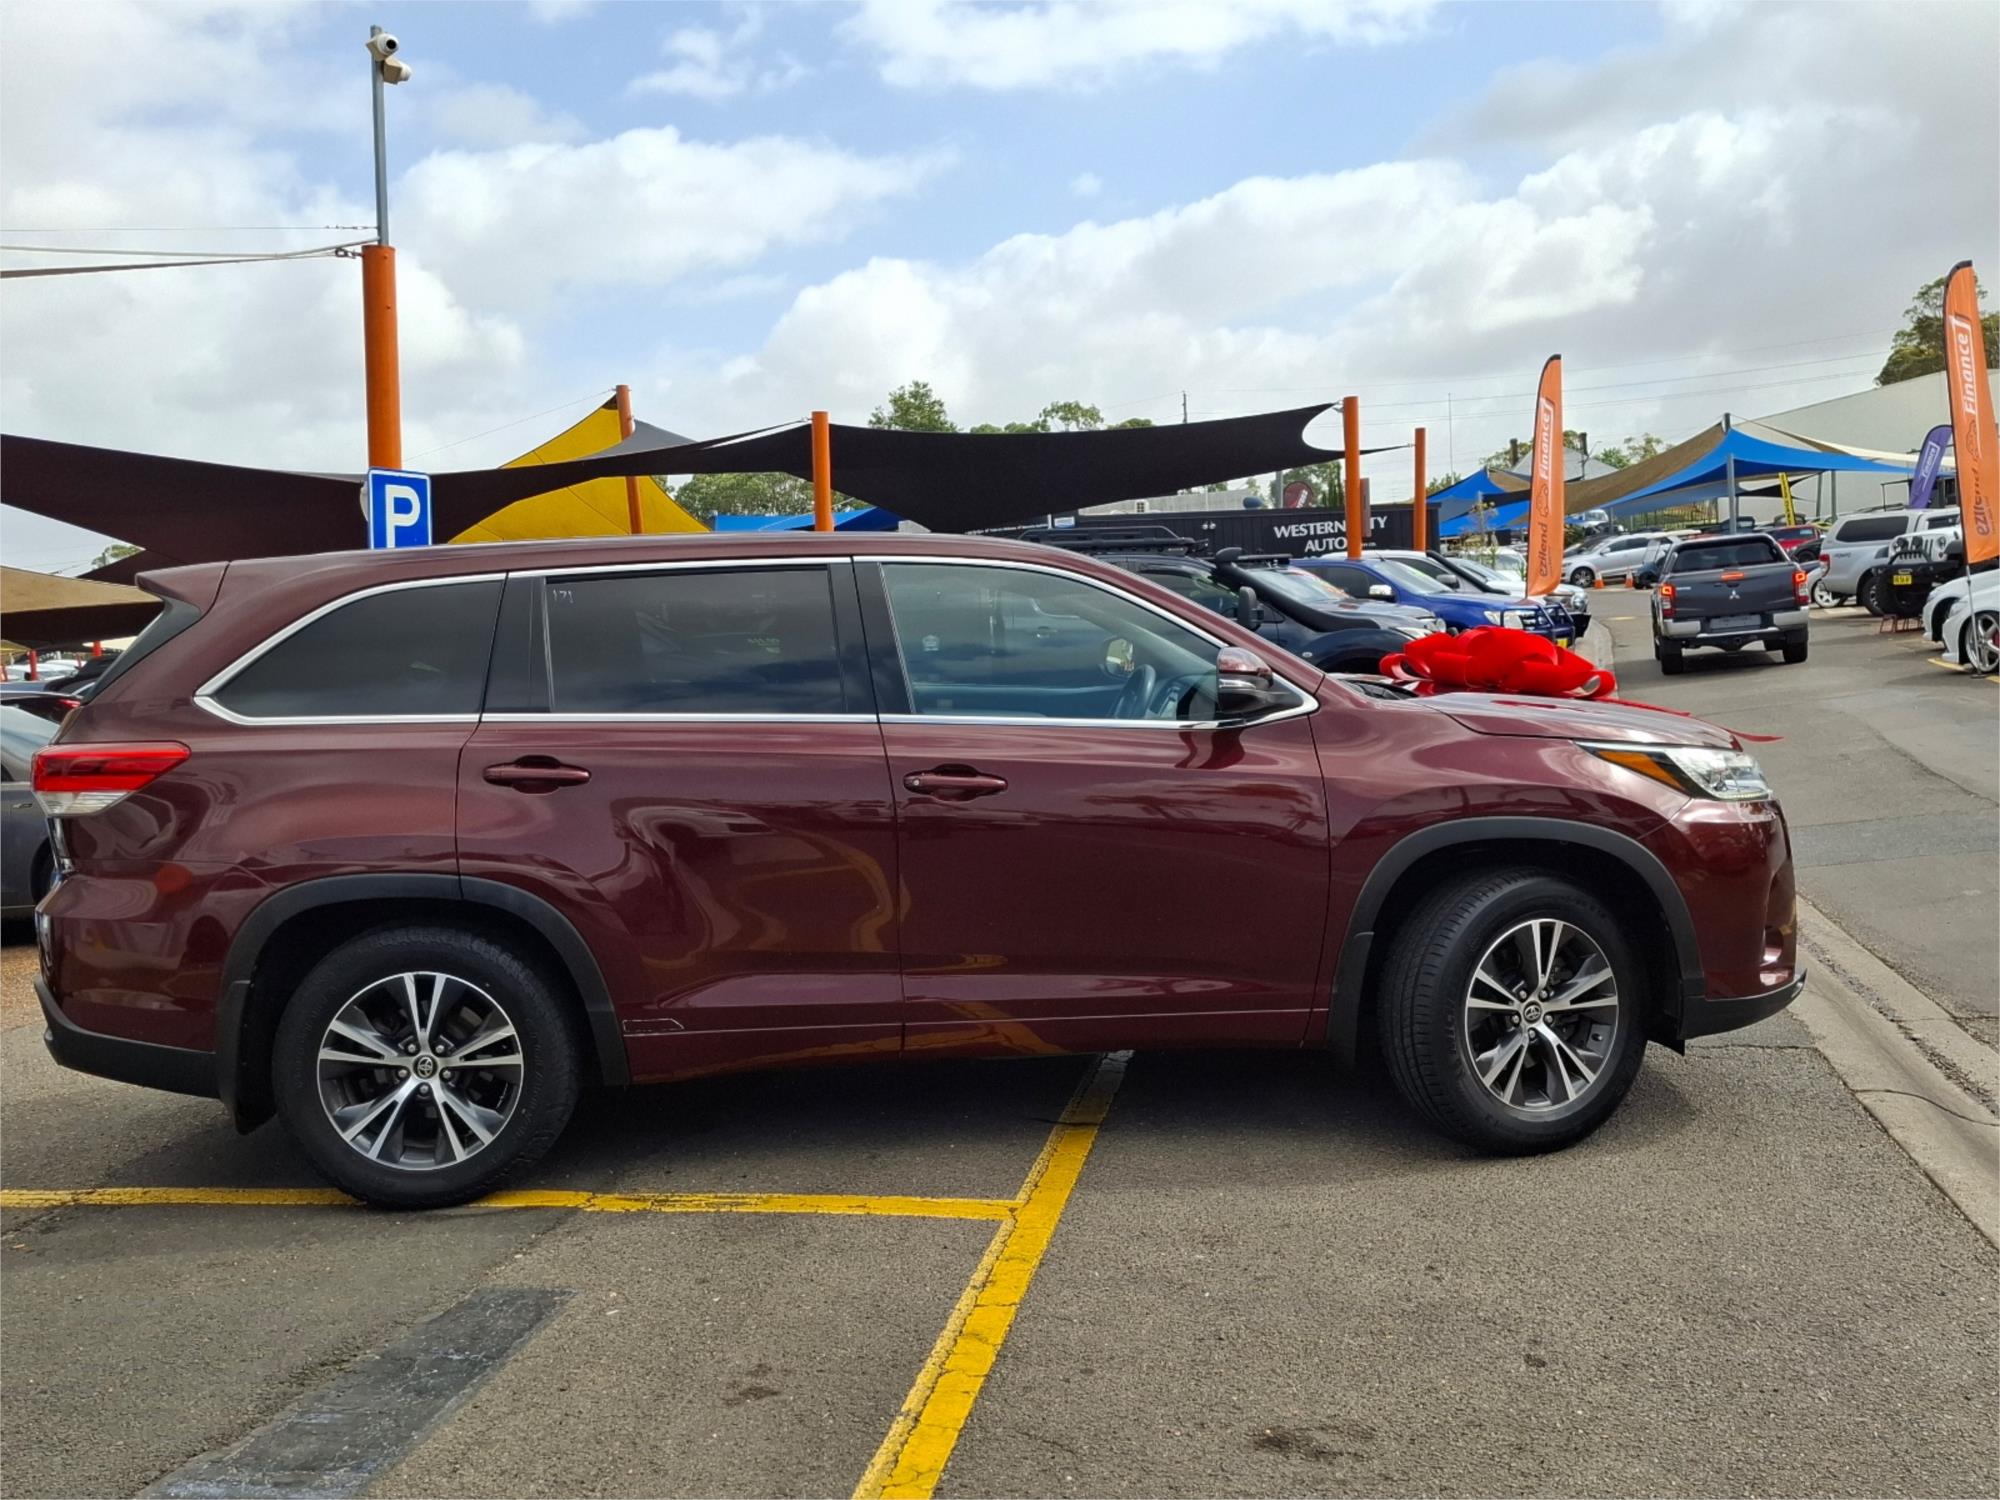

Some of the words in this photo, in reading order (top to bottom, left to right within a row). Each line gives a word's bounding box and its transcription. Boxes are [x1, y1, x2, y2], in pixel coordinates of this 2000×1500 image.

[1957, 332, 1977, 415] Finance
[1540, 411, 1551, 480] Finance
[385, 484, 421, 549] P
[1273, 520, 1347, 539] WESTERN
